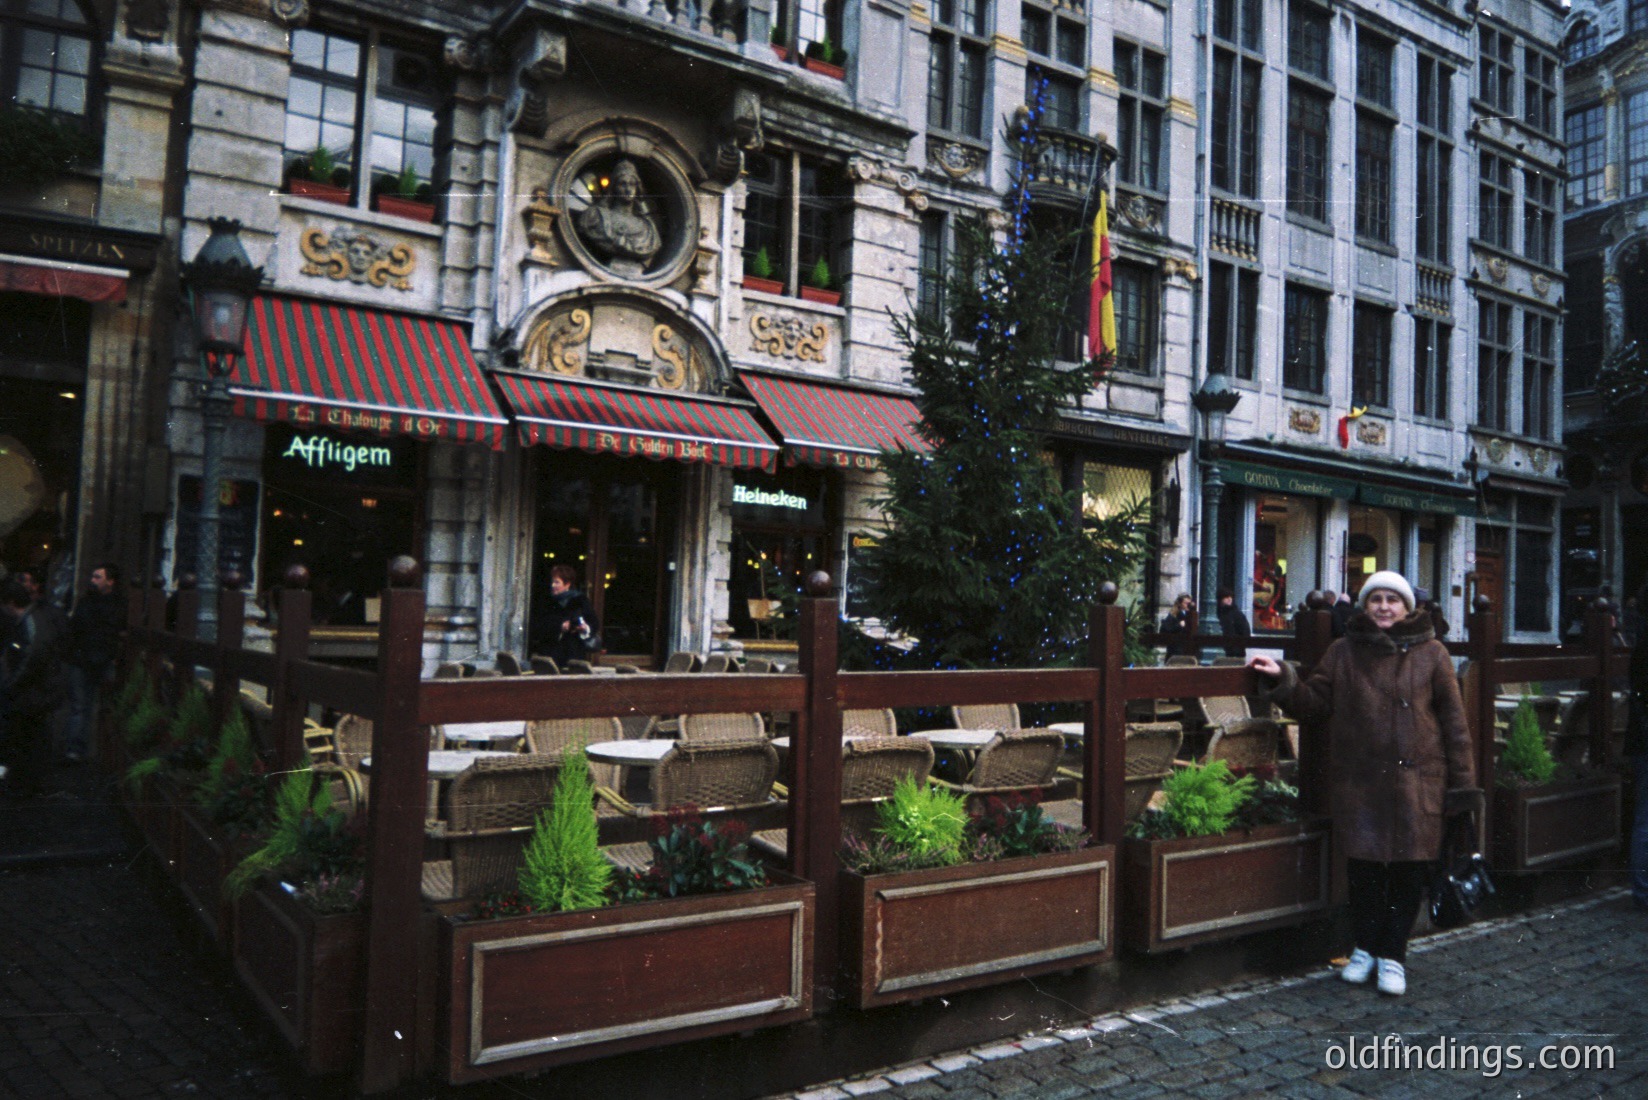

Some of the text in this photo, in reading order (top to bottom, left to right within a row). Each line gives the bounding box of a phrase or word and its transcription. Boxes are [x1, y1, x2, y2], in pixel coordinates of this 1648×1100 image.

[31, 234, 125, 260] SPITZEN
[291, 404, 315, 423] La
[327, 409, 392, 433] Chaloupe
[282, 436, 391, 472] Affligem
[600, 432, 622, 450] De
[629, 436, 674, 453] Gulden
[1244, 471, 1332, 496] GODIVA Chocolatier
[732, 484, 807, 510] Heineken
